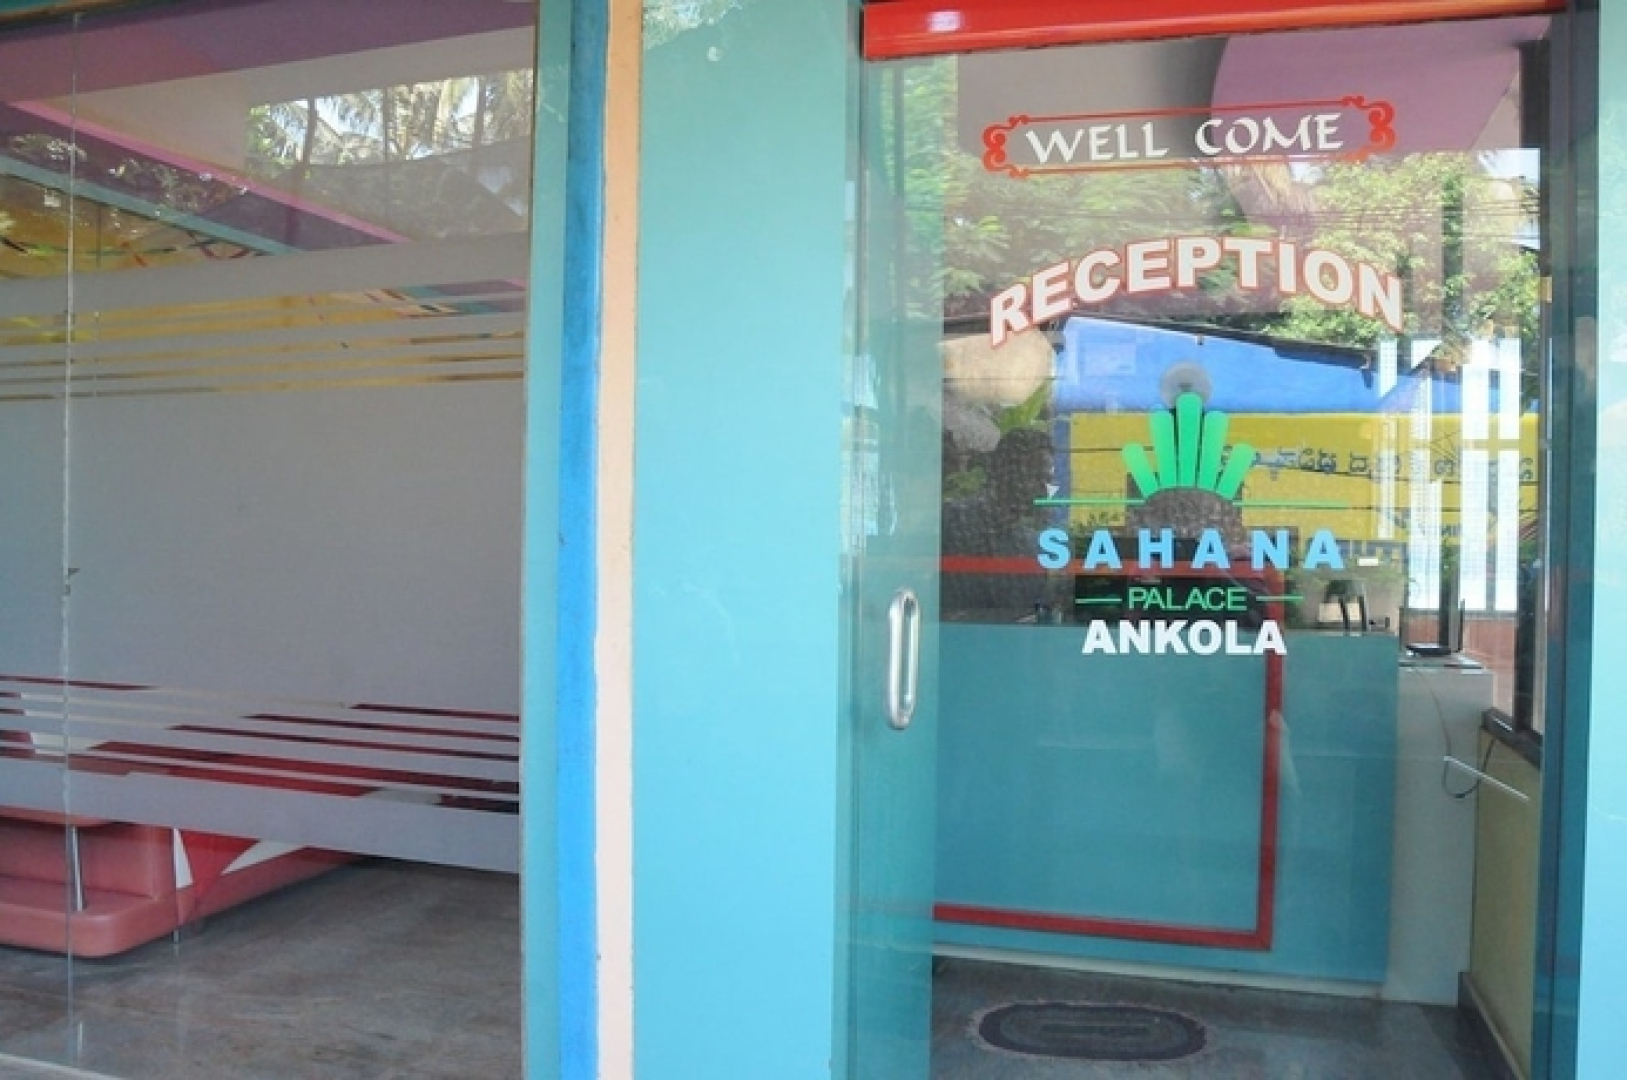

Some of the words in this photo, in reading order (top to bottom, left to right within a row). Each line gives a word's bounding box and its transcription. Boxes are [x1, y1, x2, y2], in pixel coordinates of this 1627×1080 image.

[1025, 121, 1169, 164] WELL
[1195, 112, 1344, 157] COME
[990, 235, 1403, 349] RECEPTION
[1037, 528, 1345, 570] SAHANA
[1127, 586, 1248, 612] PALACE
[1081, 619, 1287, 655] ANKOLA
